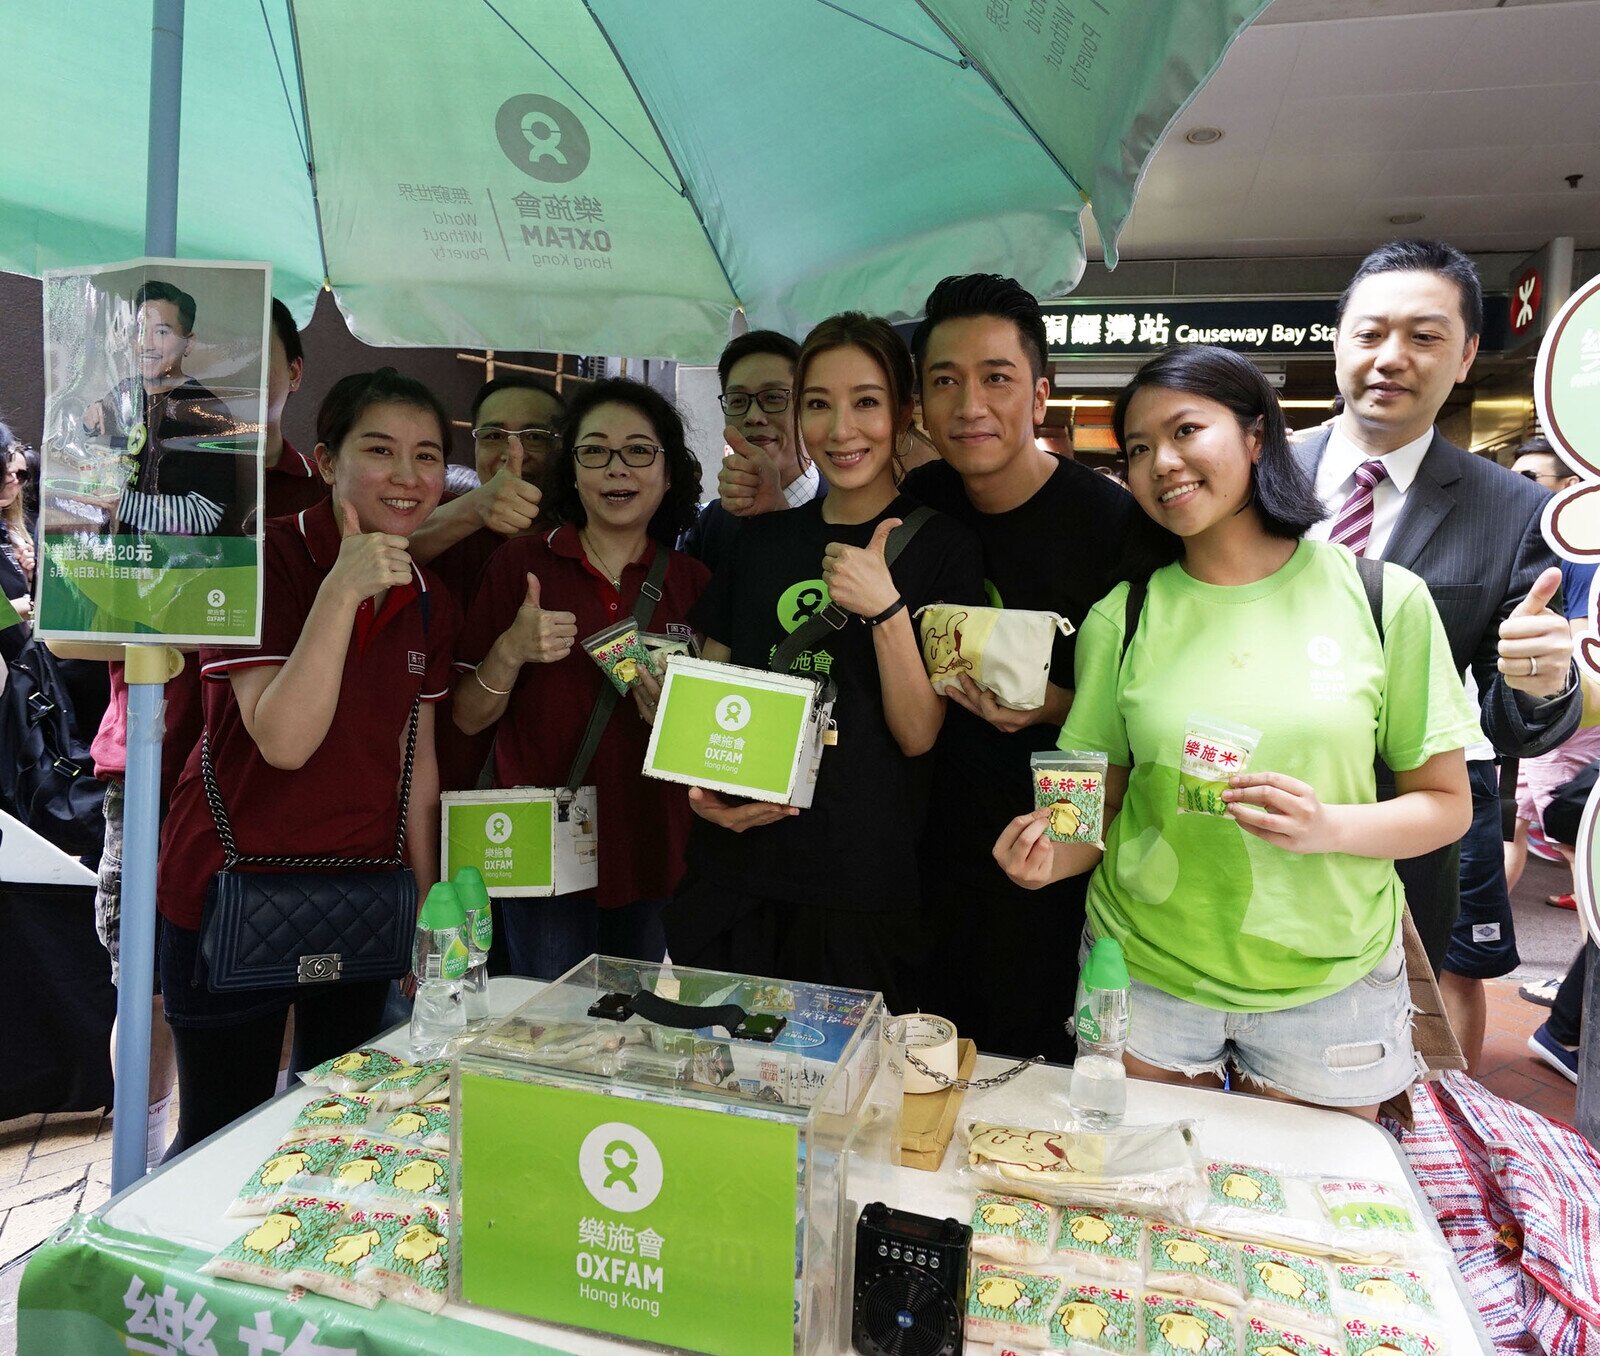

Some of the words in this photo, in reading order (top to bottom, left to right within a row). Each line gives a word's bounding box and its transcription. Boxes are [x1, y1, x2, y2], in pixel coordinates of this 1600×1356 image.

[1175, 325, 1268, 346] Causeway
[1271, 324, 1306, 345] Bay
[768, 644, 834, 675] 施會
[709, 732, 746, 751] 樂施會
[705, 747, 742, 764] OXFAM
[1185, 739, 1238, 767] 樂施米
[705, 760, 721, 771] Hong
[722, 764, 739, 775] Kong
[1039, 776, 1097, 793] 樂施米
[485, 847, 512, 858] 樂施會
[485, 860, 512, 870] OXFAM
[578, 1216, 665, 1260] 樂施會
[576, 1252, 664, 1294] OXFAM
[580, 1283, 618, 1309] Hong
[622, 1291, 660, 1318] Kong
[1346, 1320, 1436, 1355] 樂施米
